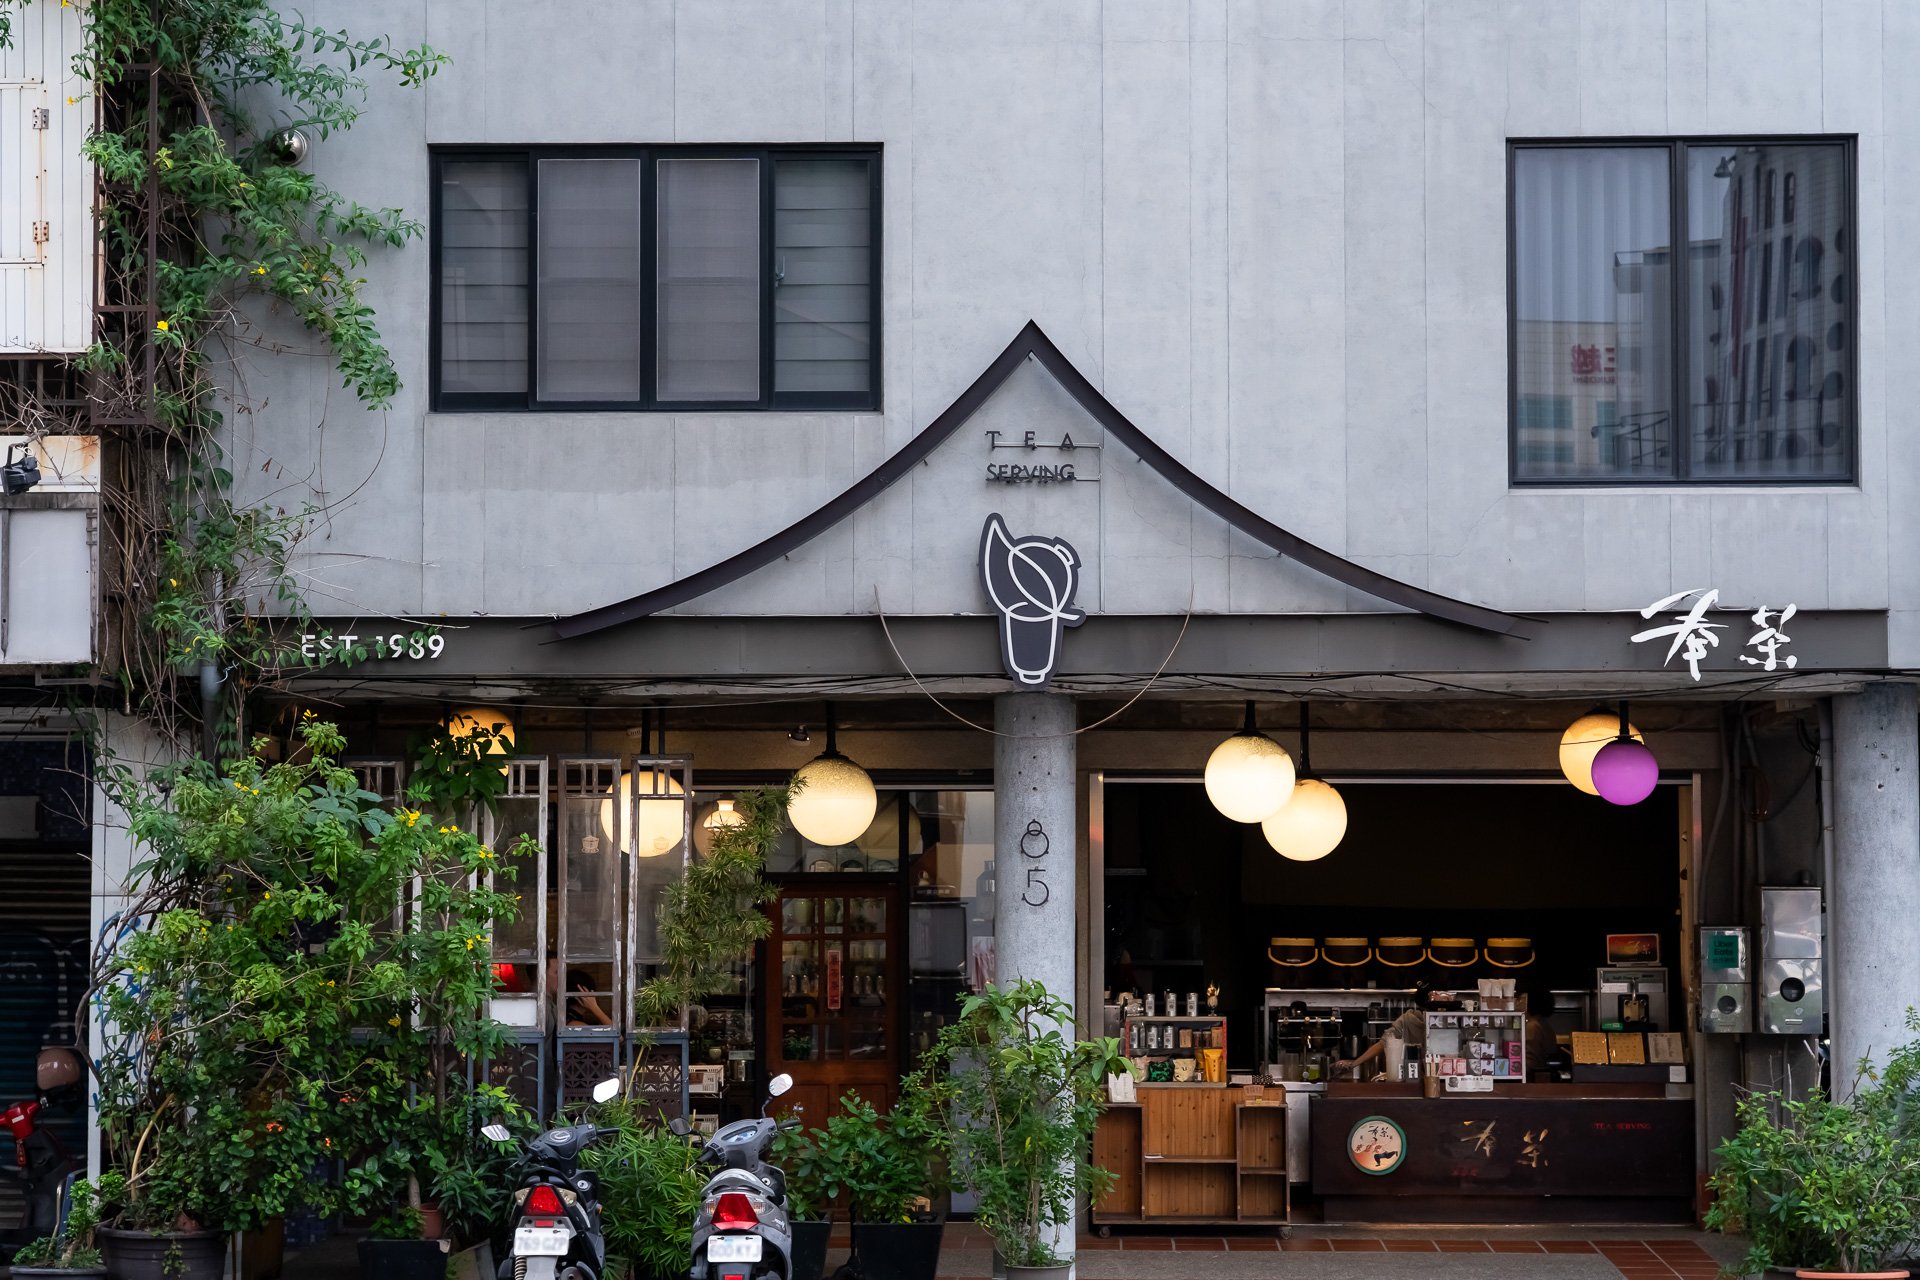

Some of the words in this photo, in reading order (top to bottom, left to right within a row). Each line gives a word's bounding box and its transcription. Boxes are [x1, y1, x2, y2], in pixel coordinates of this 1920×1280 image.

[985, 430, 1077, 450] TEA
[986, 463, 1077, 483] SERVING
[301, 634, 358, 658] EST
